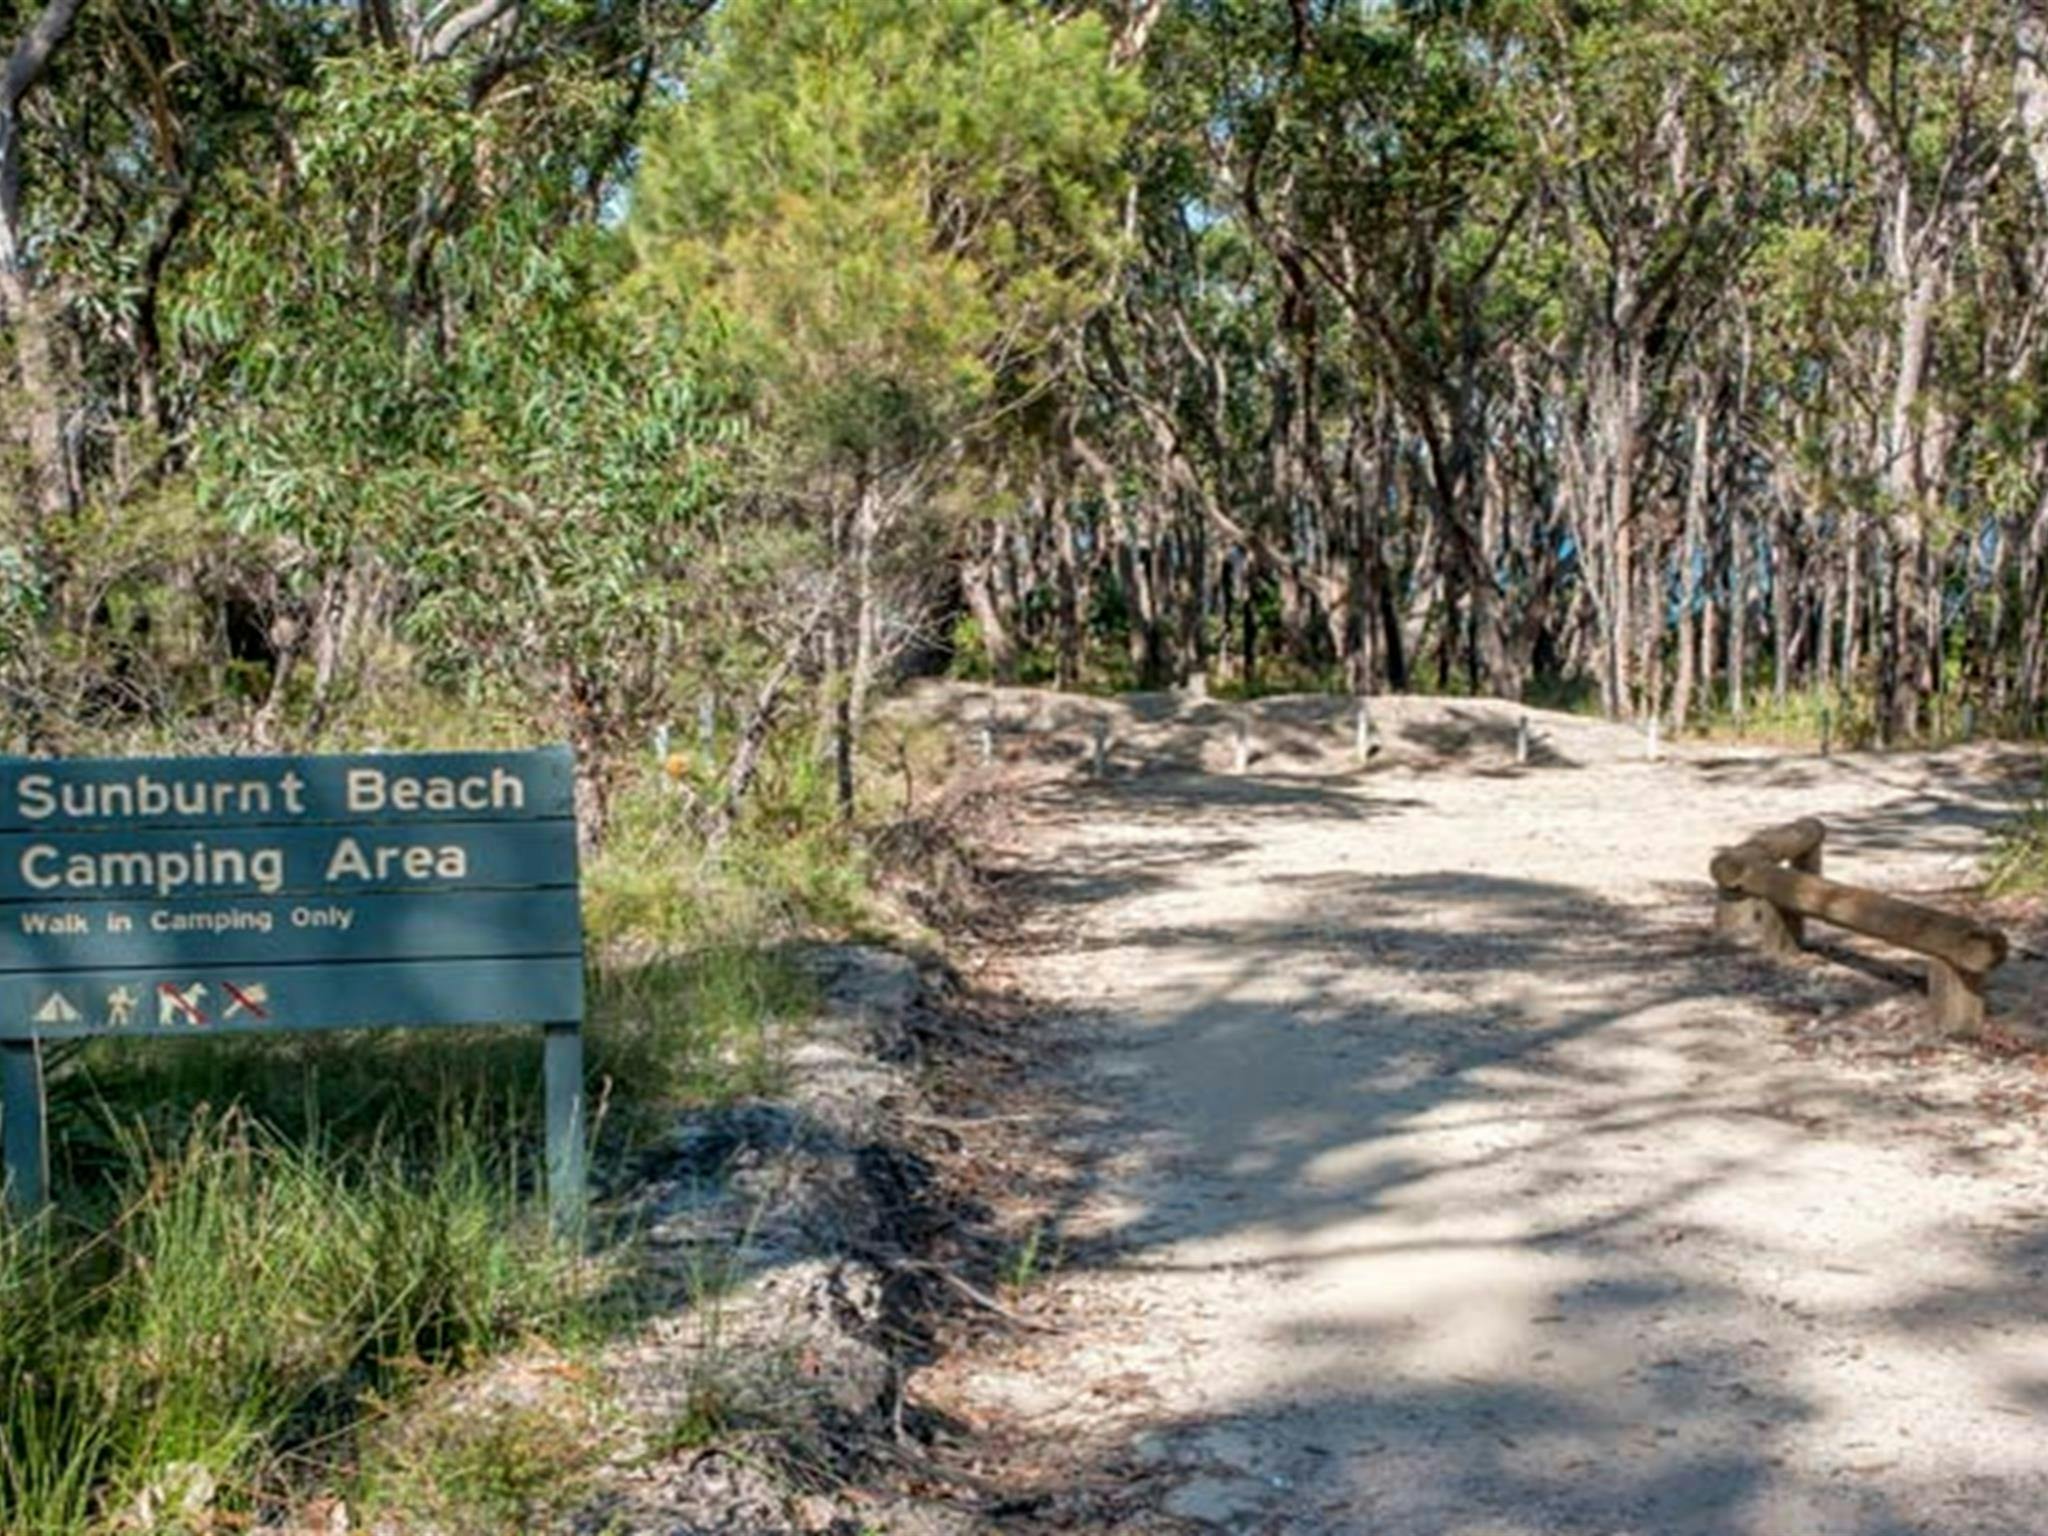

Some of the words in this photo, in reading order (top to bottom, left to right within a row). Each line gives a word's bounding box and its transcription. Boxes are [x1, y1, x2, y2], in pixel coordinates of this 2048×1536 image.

[18, 771, 306, 818] Sunburnt
[347, 768, 525, 812] Beach
[20, 842, 285, 894] Camping
[326, 838, 468, 881] Area
[21, 911, 89, 935] Walk
[107, 912, 132, 932] in
[151, 909, 273, 935] Camping
[291, 906, 354, 930] Only
